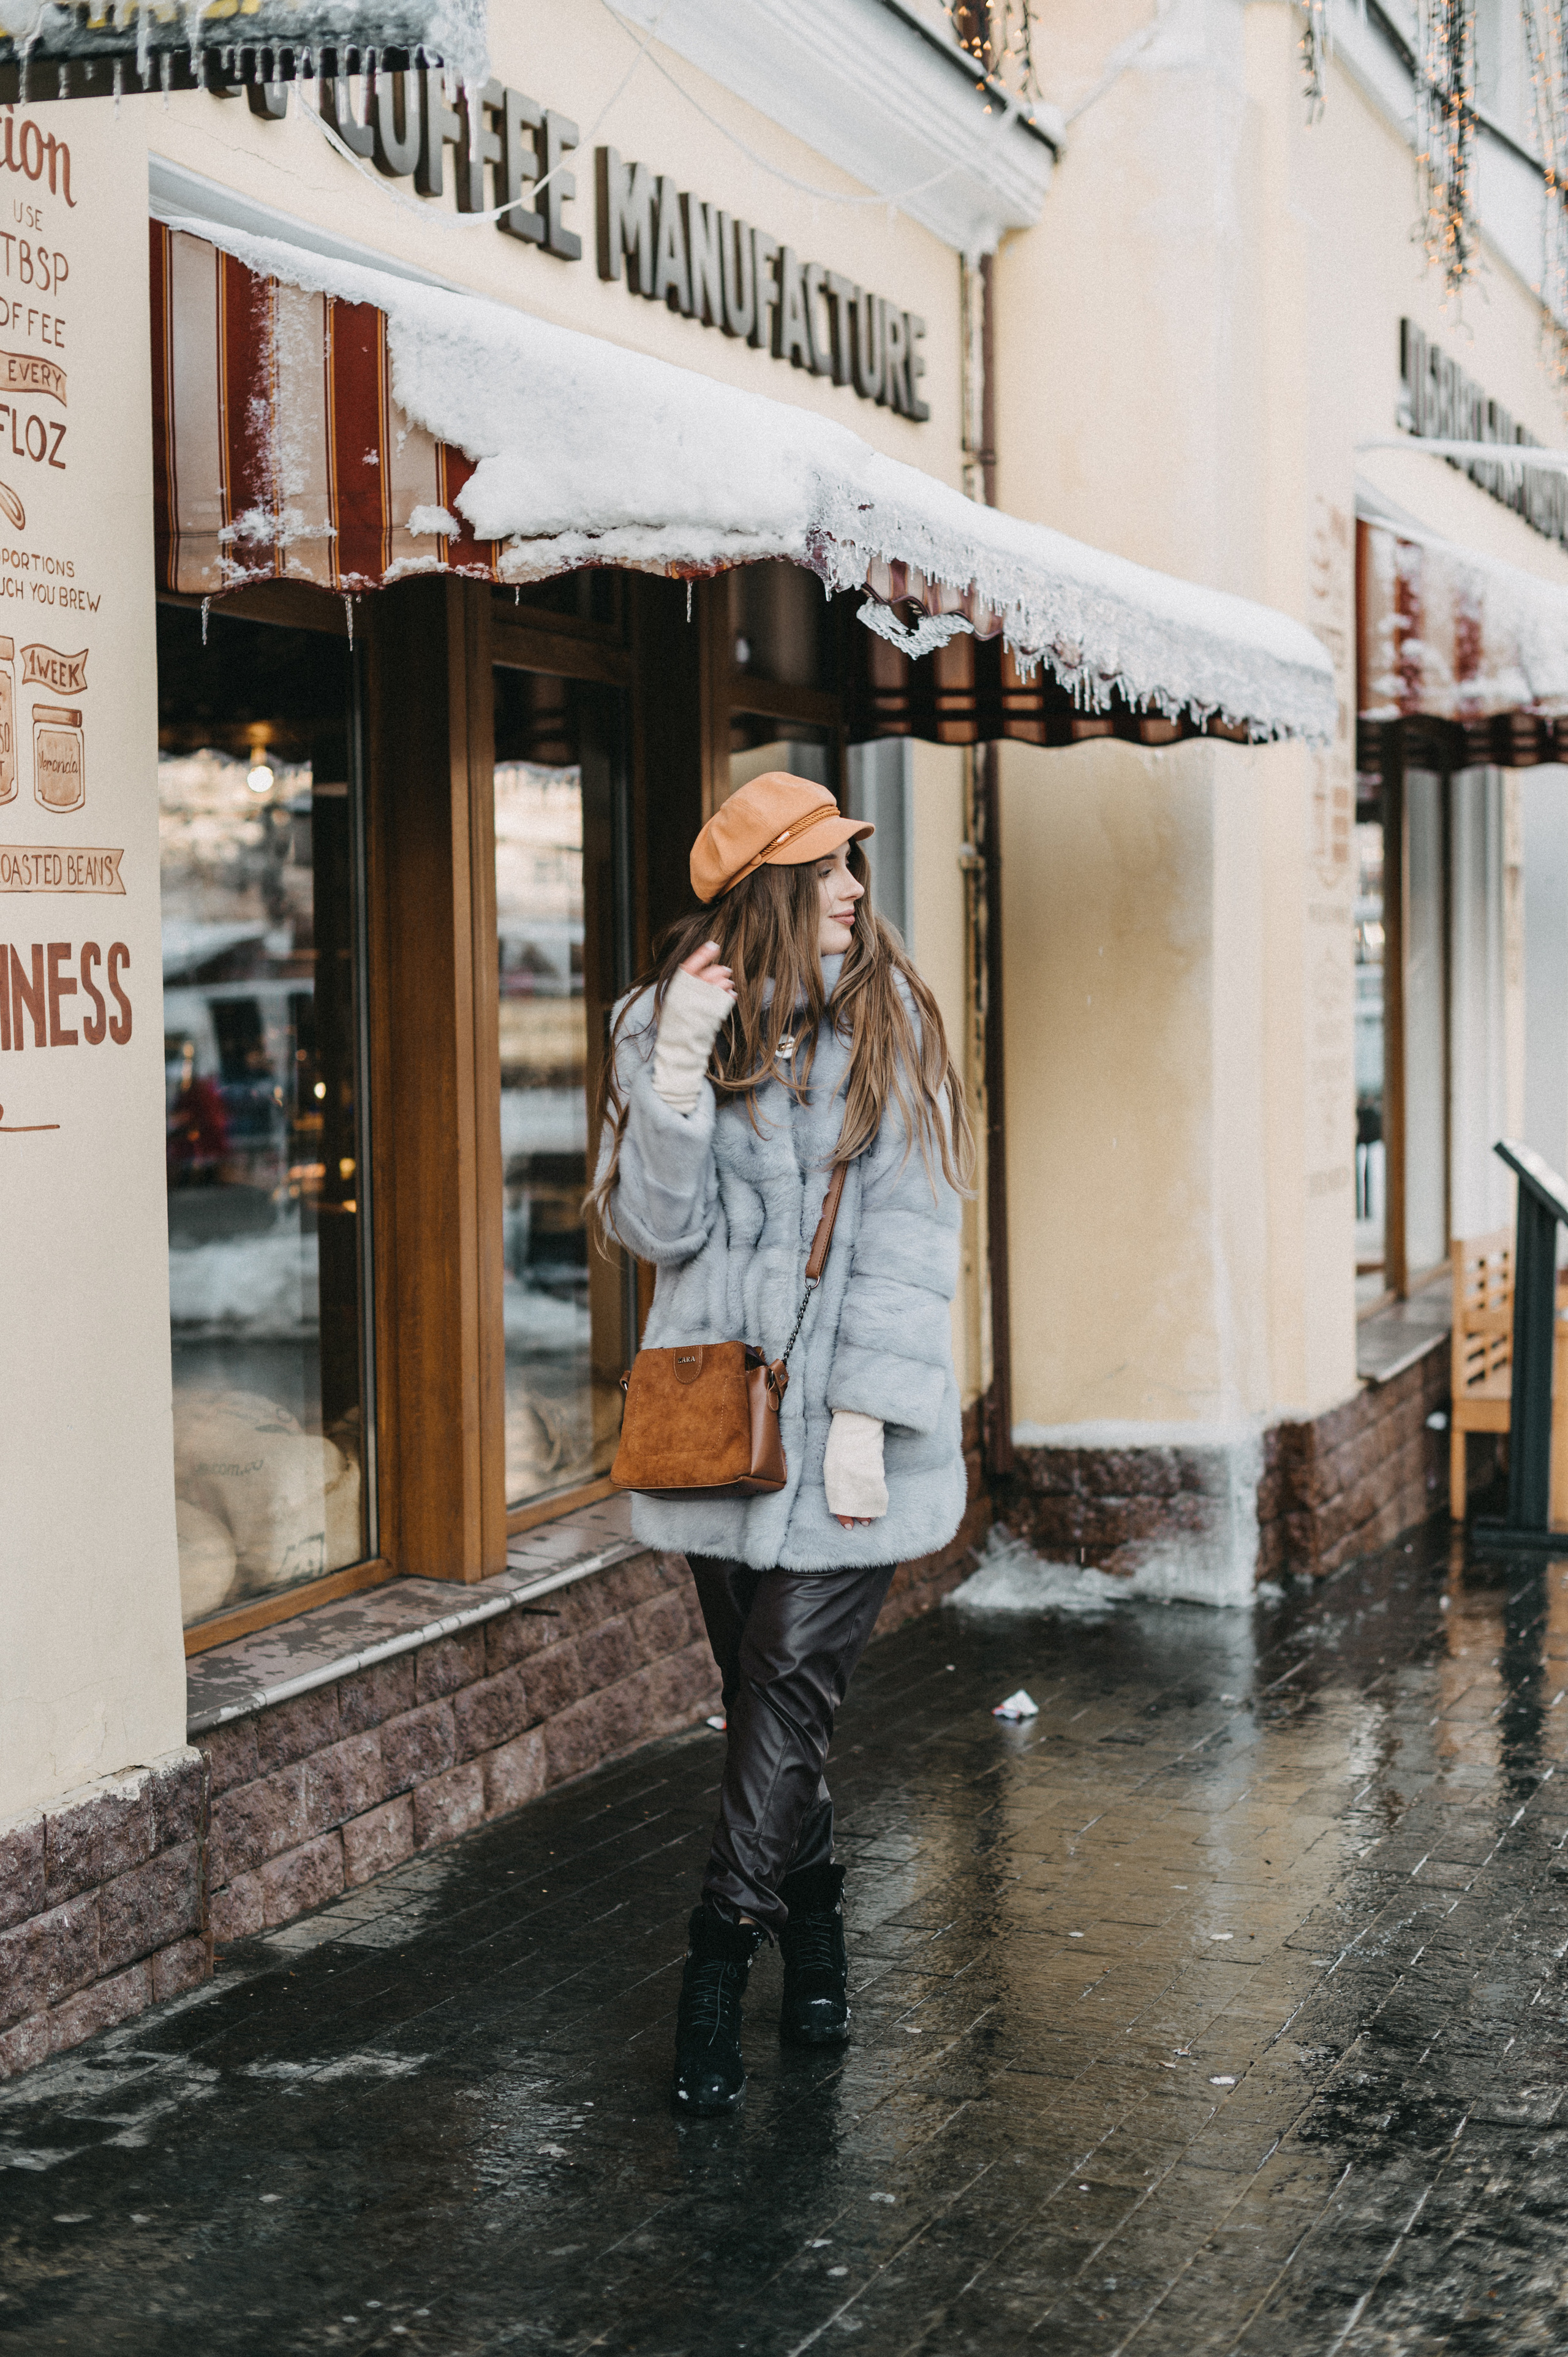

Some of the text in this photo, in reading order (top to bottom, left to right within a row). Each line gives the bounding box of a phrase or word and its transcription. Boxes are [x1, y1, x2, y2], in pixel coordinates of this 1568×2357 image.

[0, 104, 77, 208] ion
[13, 199, 43, 232] USE
[595, 146, 930, 423] MANUFACTURE
[8, 359, 62, 392] EVERY
[29, 581, 55, 605] YOU
[59, 586, 101, 613] BREW
[39, 751, 78, 774] Veranda
[0, 853, 114, 887] OASTED BEANS
